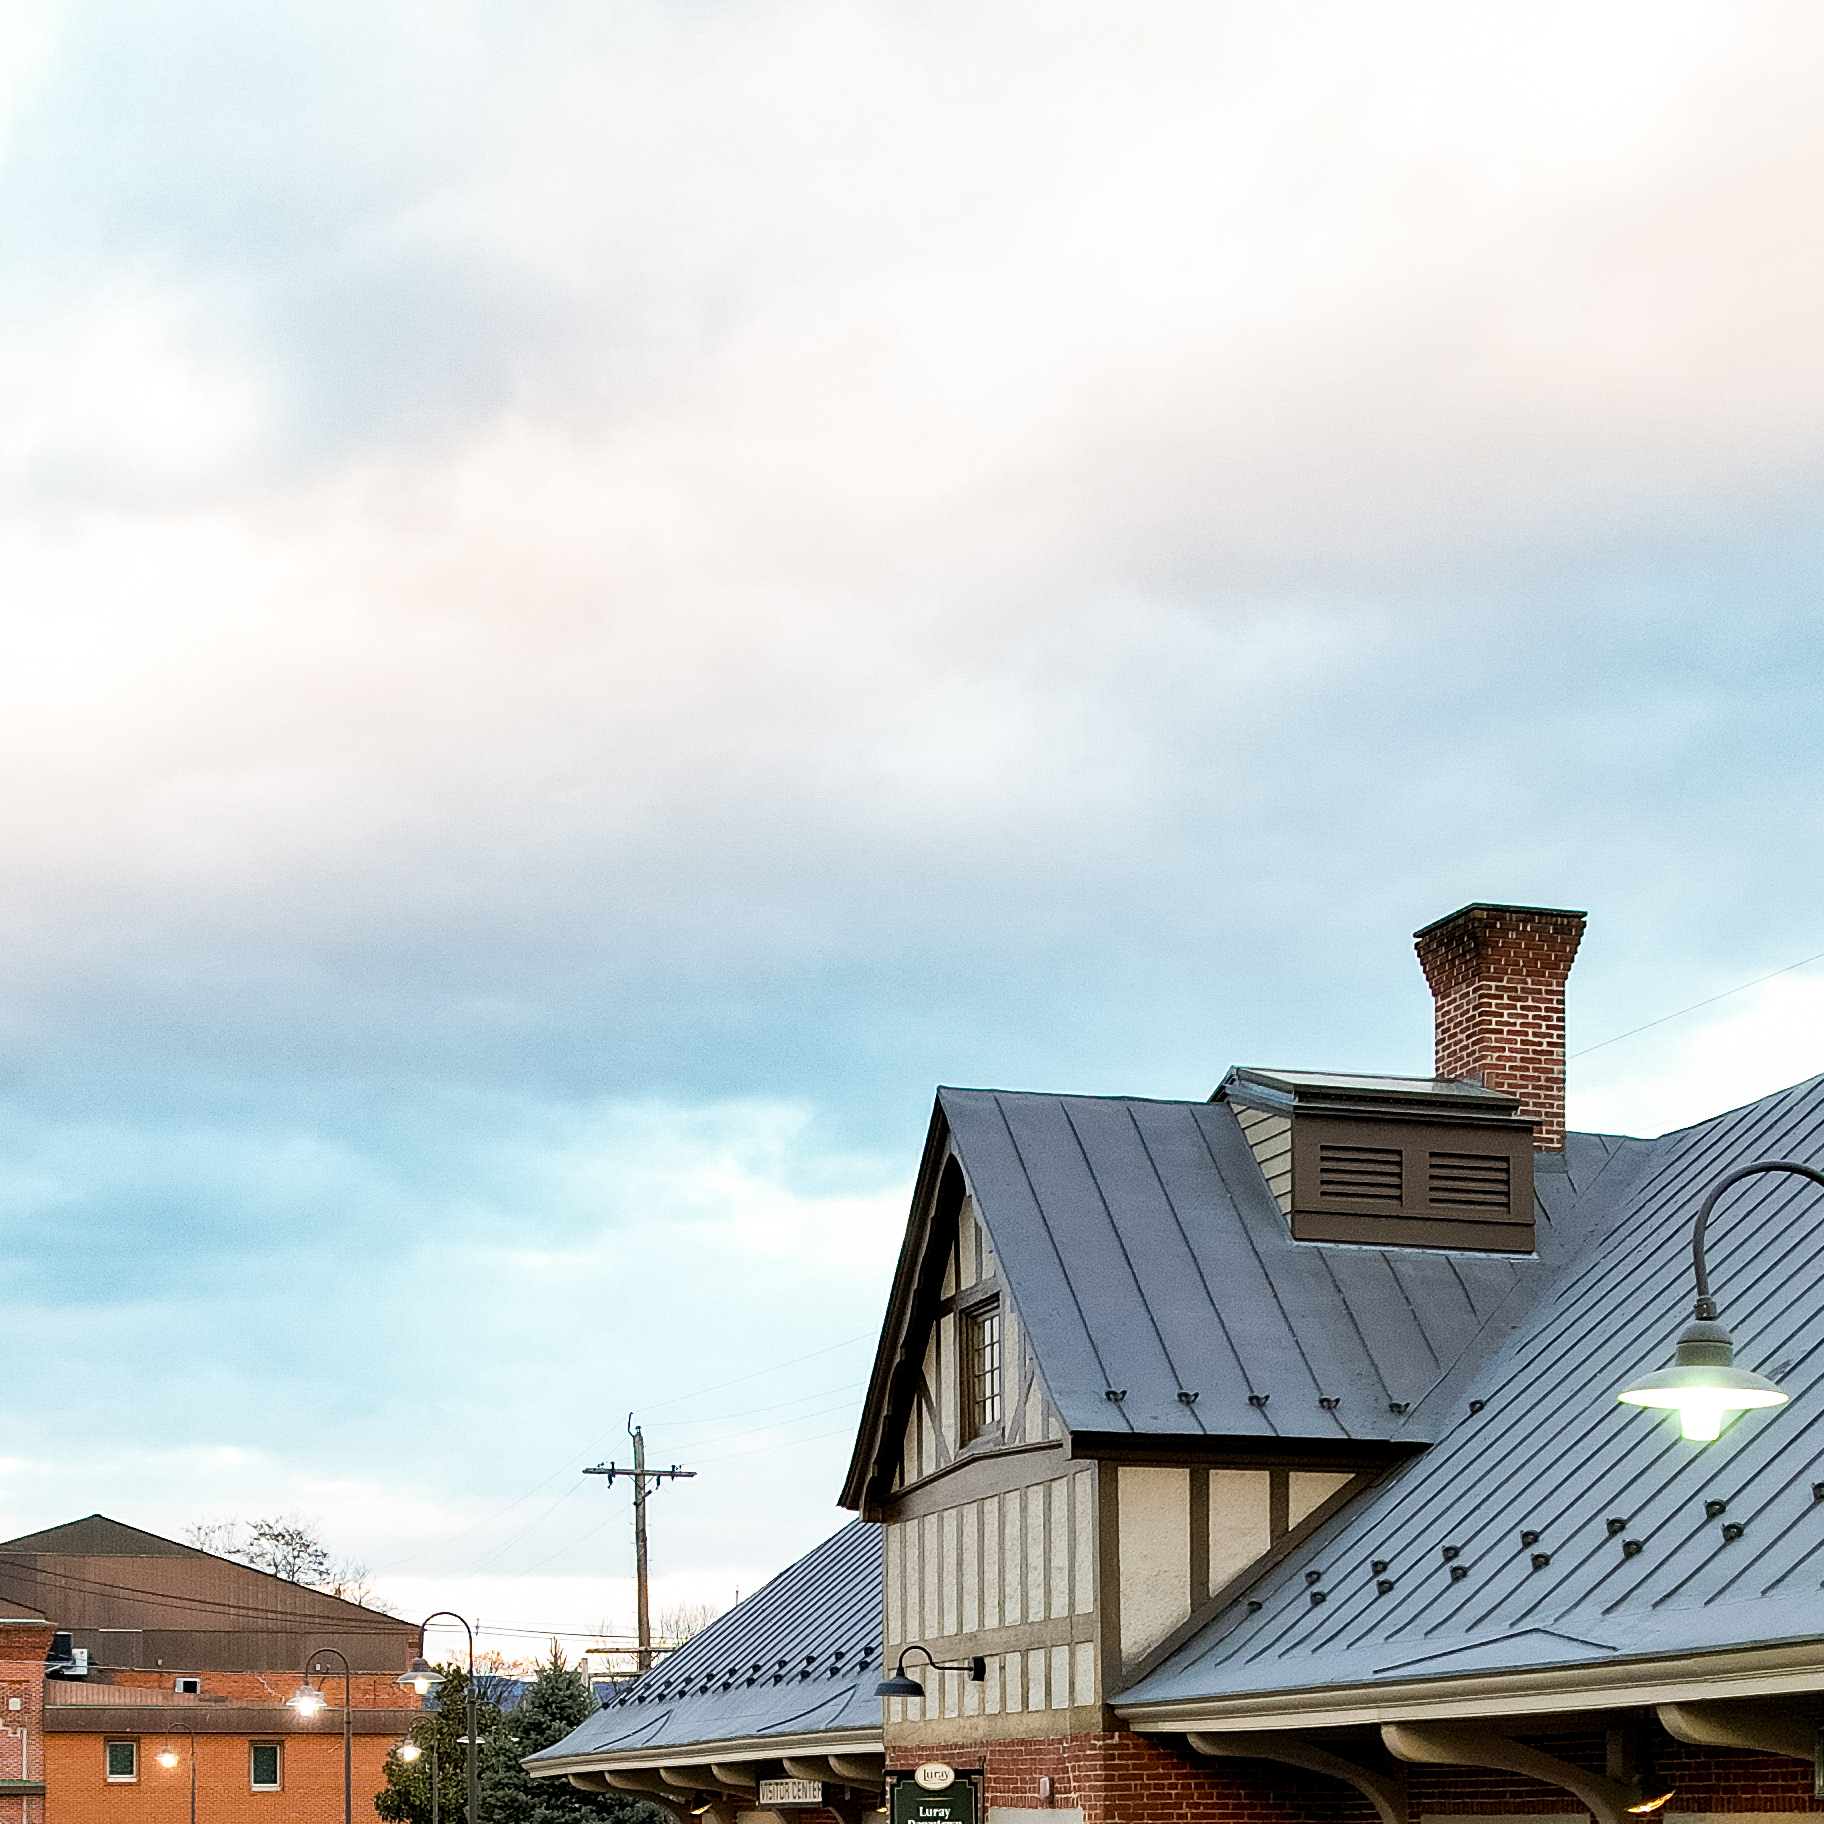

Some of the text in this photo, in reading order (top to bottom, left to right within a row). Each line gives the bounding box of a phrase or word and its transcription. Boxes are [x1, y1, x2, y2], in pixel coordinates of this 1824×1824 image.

[923, 1768, 949, 1781] Luray
[761, 1781, 790, 1801] VISITOR
[919, 1806, 951, 1820] Luray
